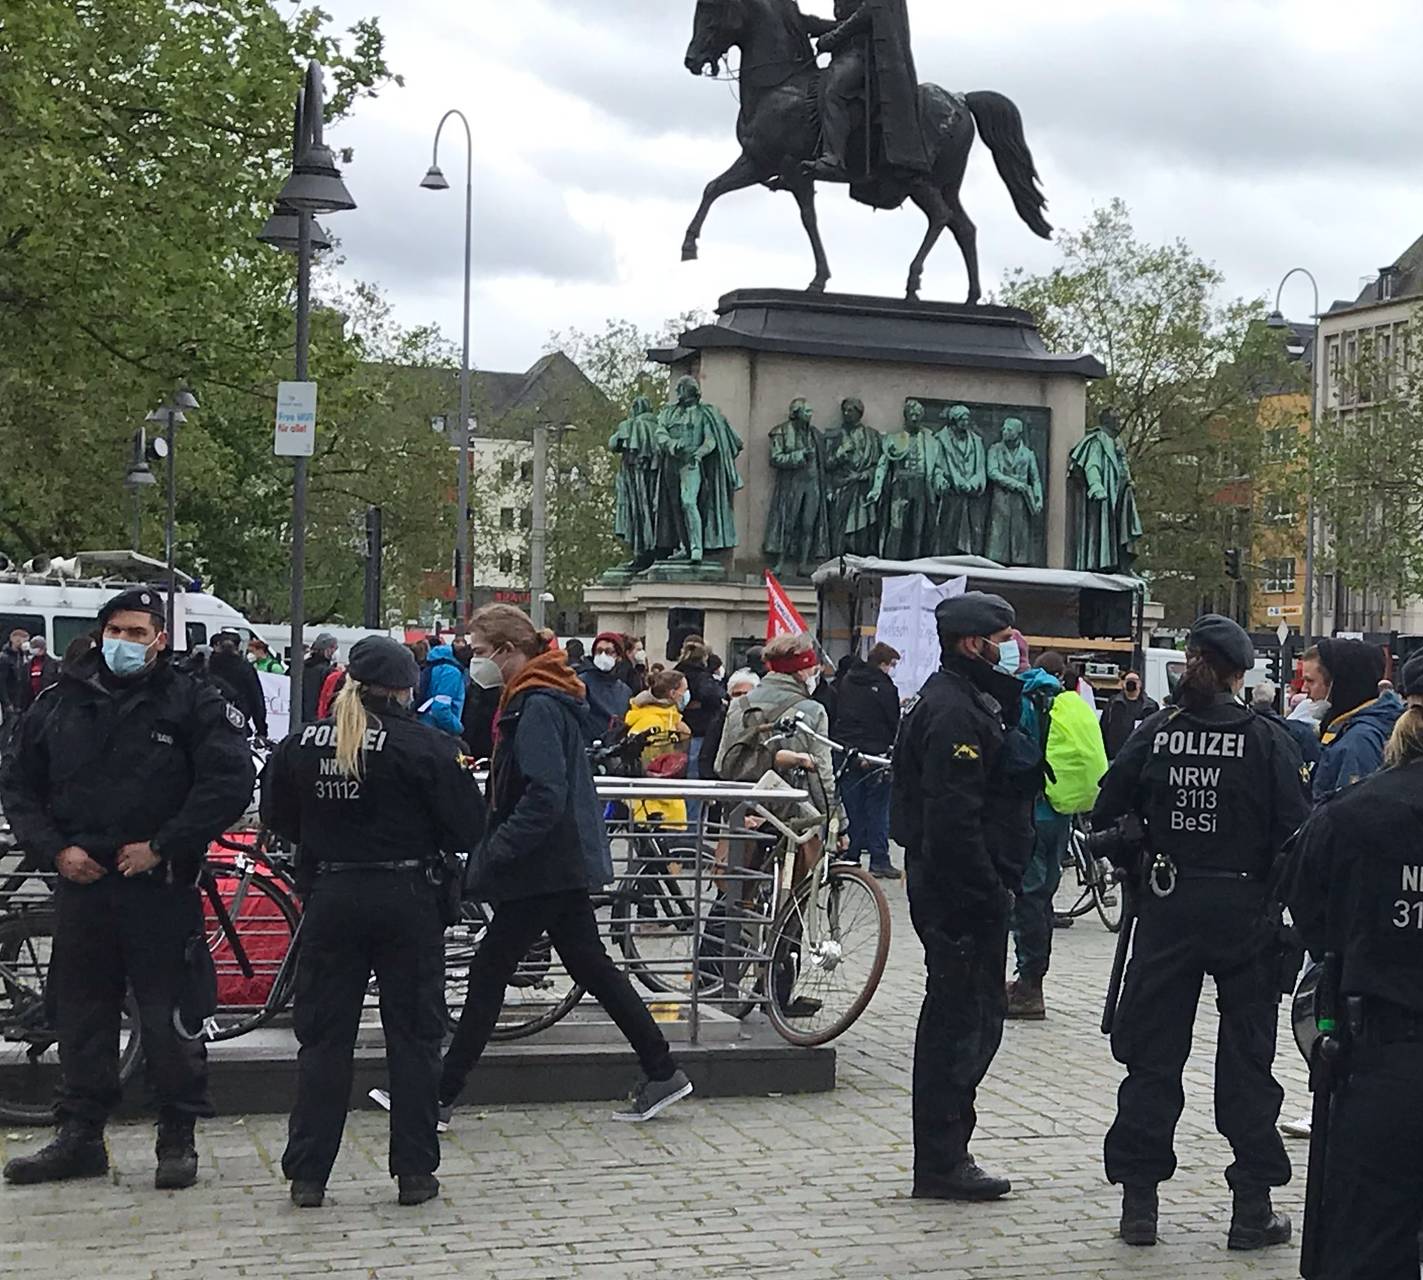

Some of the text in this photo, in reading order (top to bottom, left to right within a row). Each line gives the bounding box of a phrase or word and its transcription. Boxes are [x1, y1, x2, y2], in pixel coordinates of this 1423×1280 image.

[300, 725, 387, 752] POLEI
[1152, 730, 1245, 758] POLIZEI
[1169, 766, 1221, 787] NRW
[315, 780, 360, 799] 31112
[1176, 788, 1217, 809] 3113
[1171, 810, 1217, 833] BeSi
